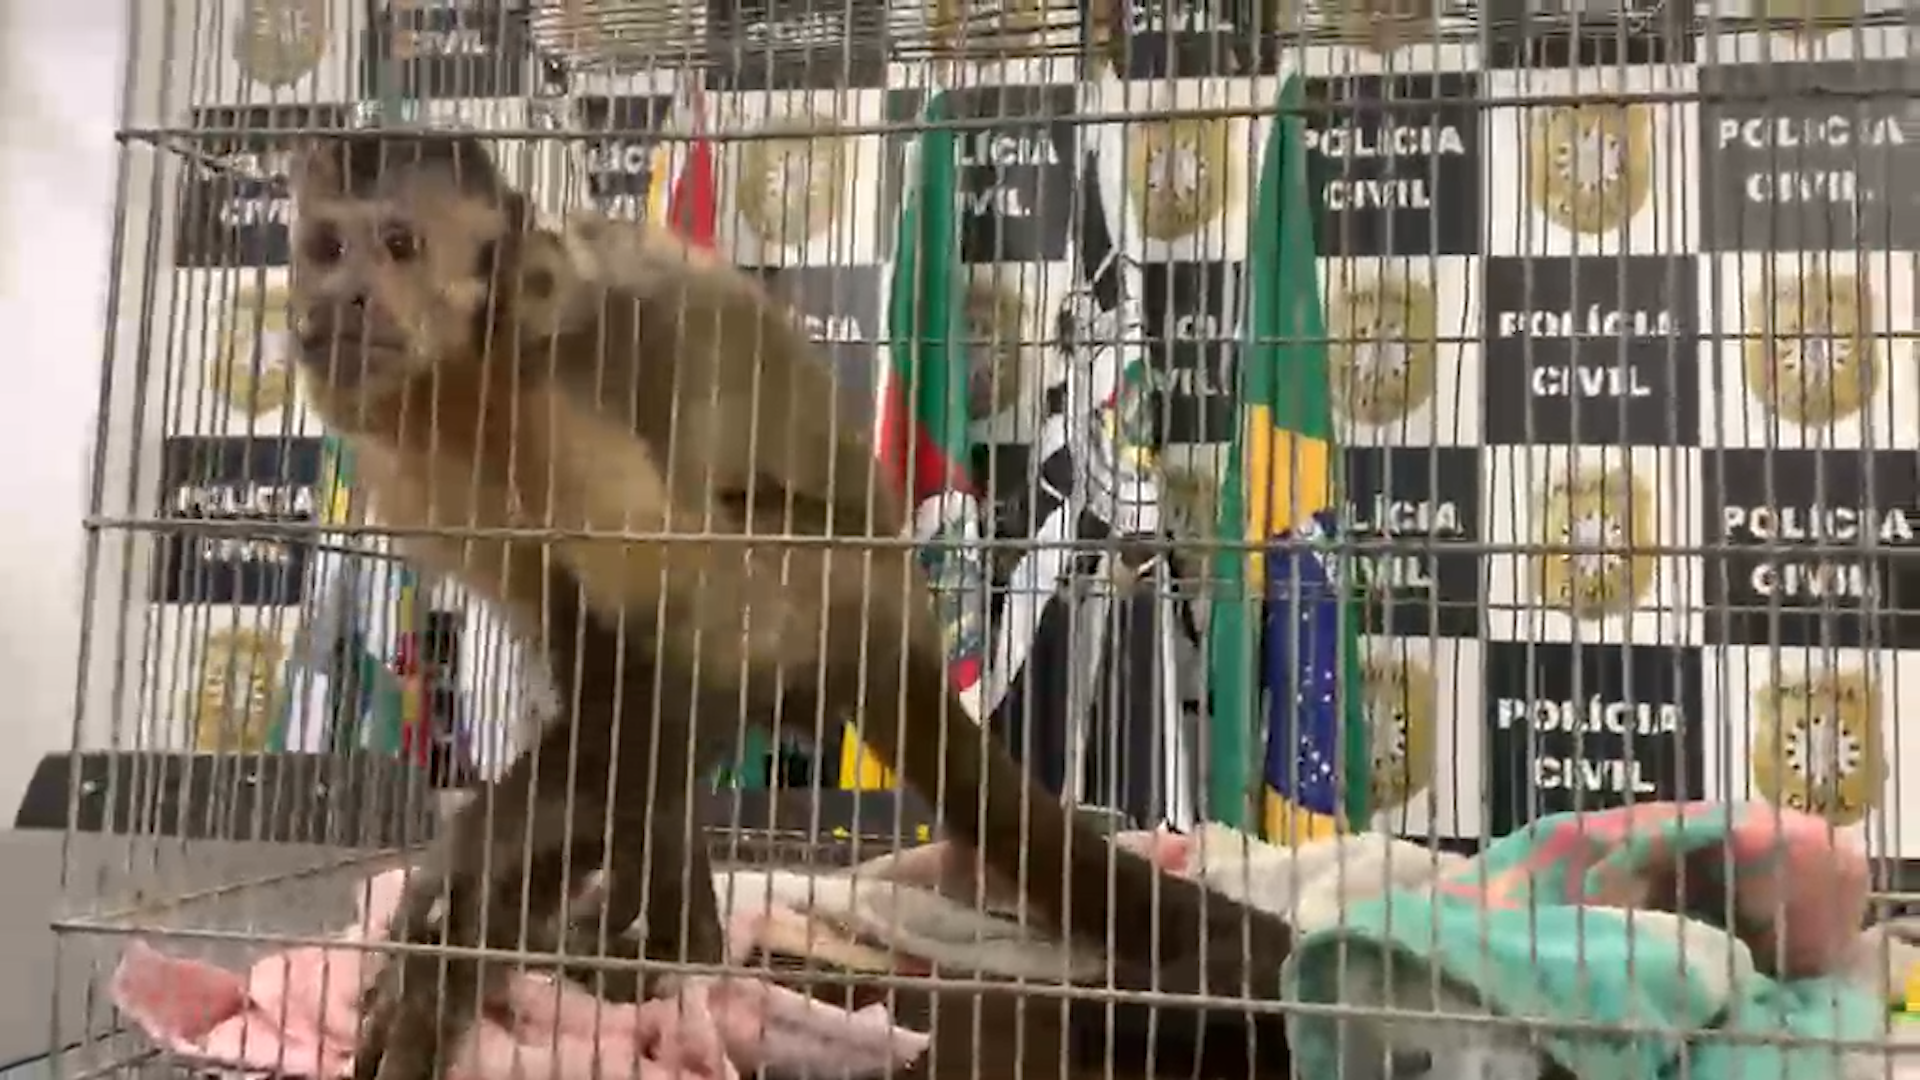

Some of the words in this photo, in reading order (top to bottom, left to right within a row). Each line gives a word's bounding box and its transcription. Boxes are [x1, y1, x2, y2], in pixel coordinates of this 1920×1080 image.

[953, 130, 1060, 166] LÍCIA
[953, 187, 1031, 217] IVIL
[1323, 179, 1430, 210] CIVIL
[1747, 170, 1874, 203] CIVIL
[1532, 365, 1651, 396] CIVIL
[1345, 493, 1466, 536] LÍCIA
[1752, 563, 1879, 597] CIVIL
[1498, 692, 1686, 735] POLÍCIA
[1534, 757, 1656, 793] CIVIL
